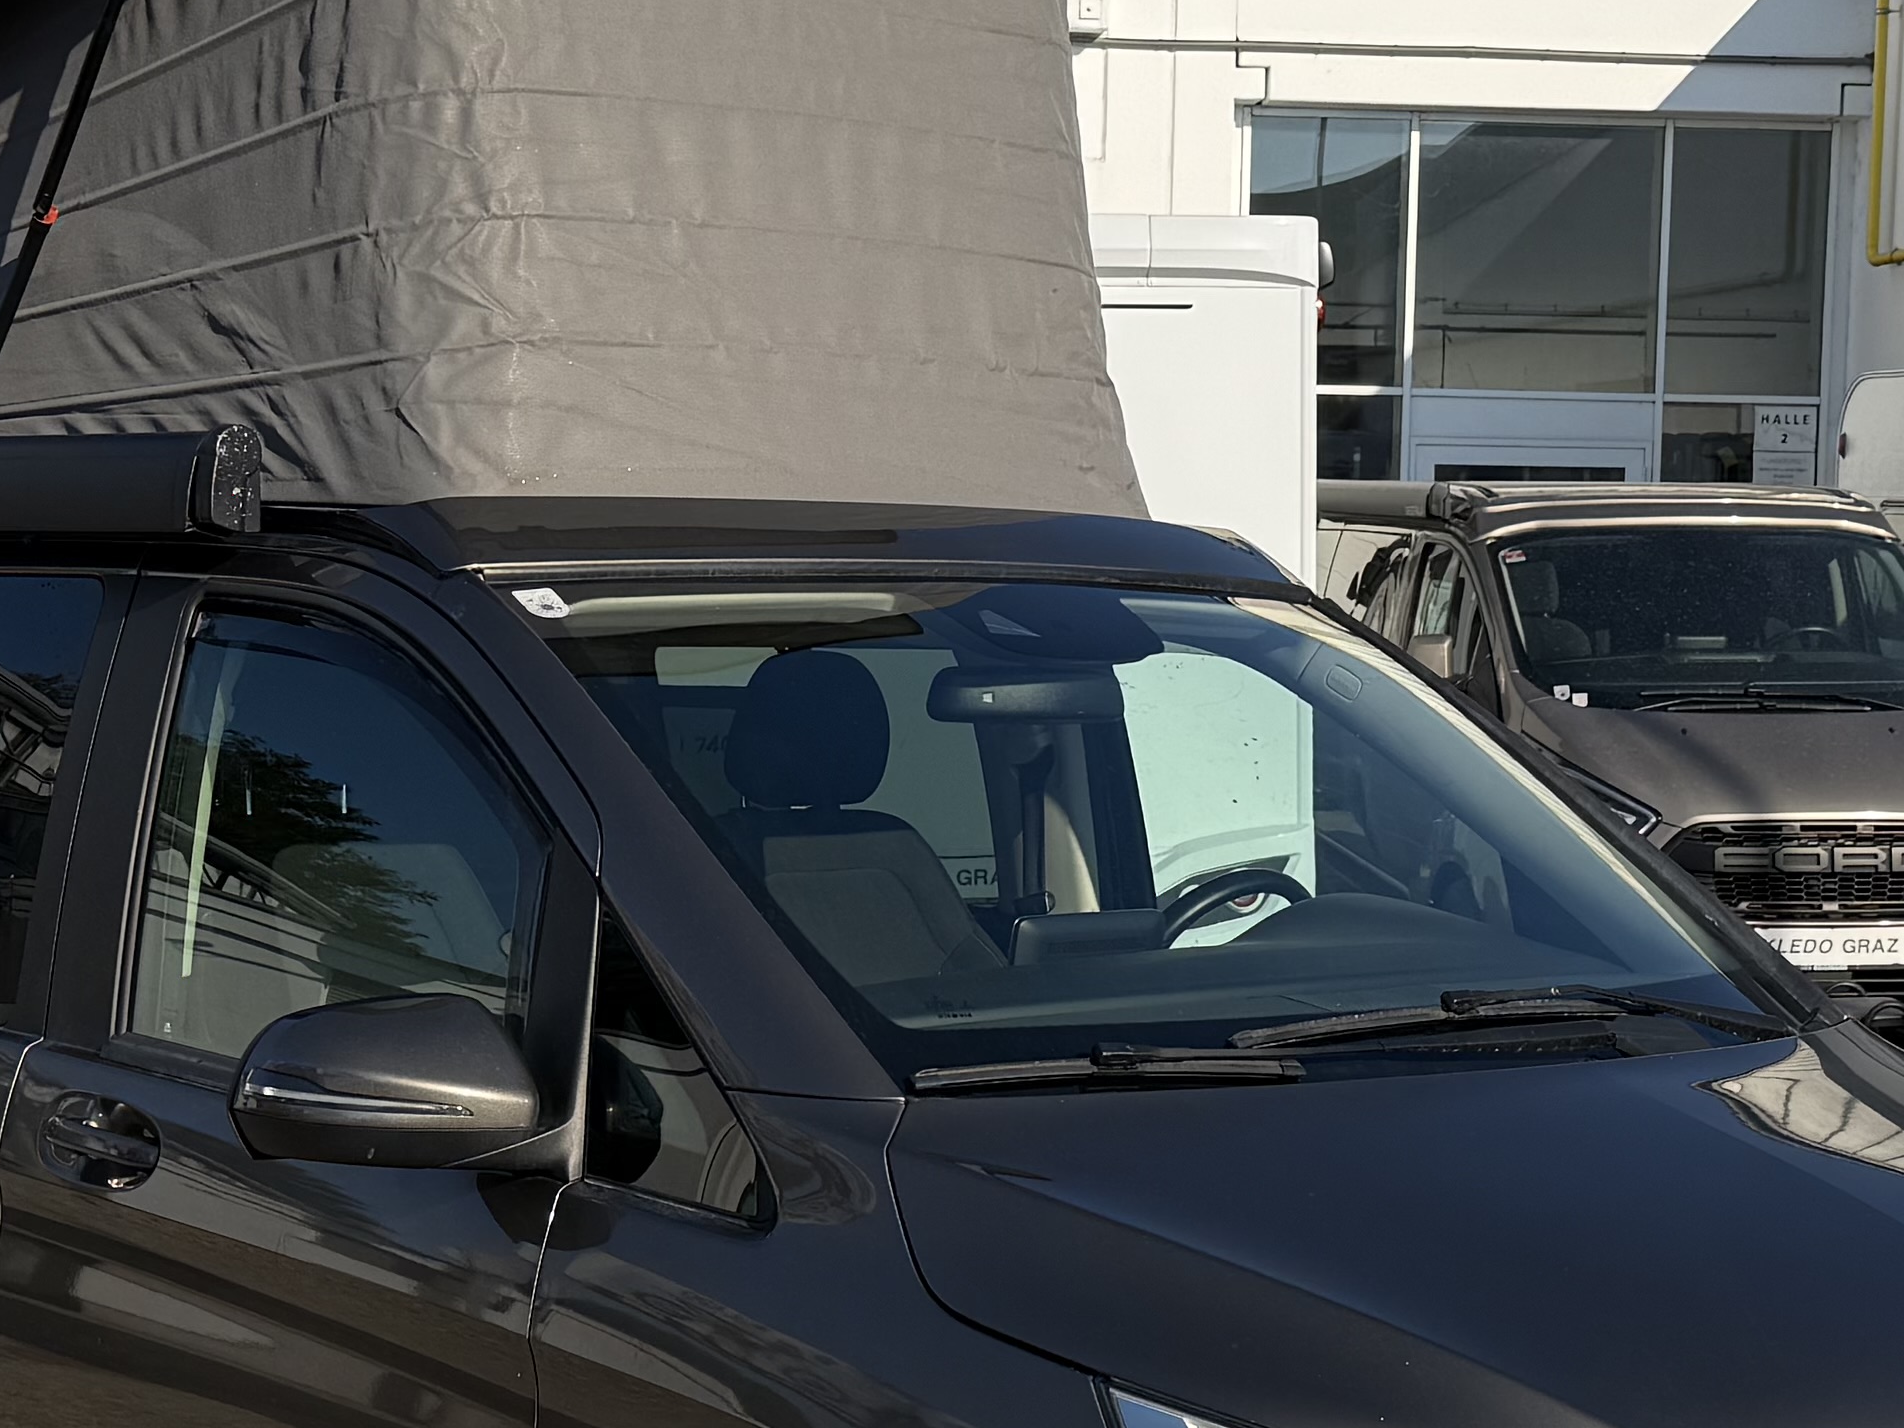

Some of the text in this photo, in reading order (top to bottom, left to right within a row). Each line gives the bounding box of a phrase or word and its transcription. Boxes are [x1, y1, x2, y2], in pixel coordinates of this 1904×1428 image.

[1760, 413, 1811, 426] HALLE
[1780, 432, 1789, 445] 2
[1842, 938, 1900, 954] GRAZ
